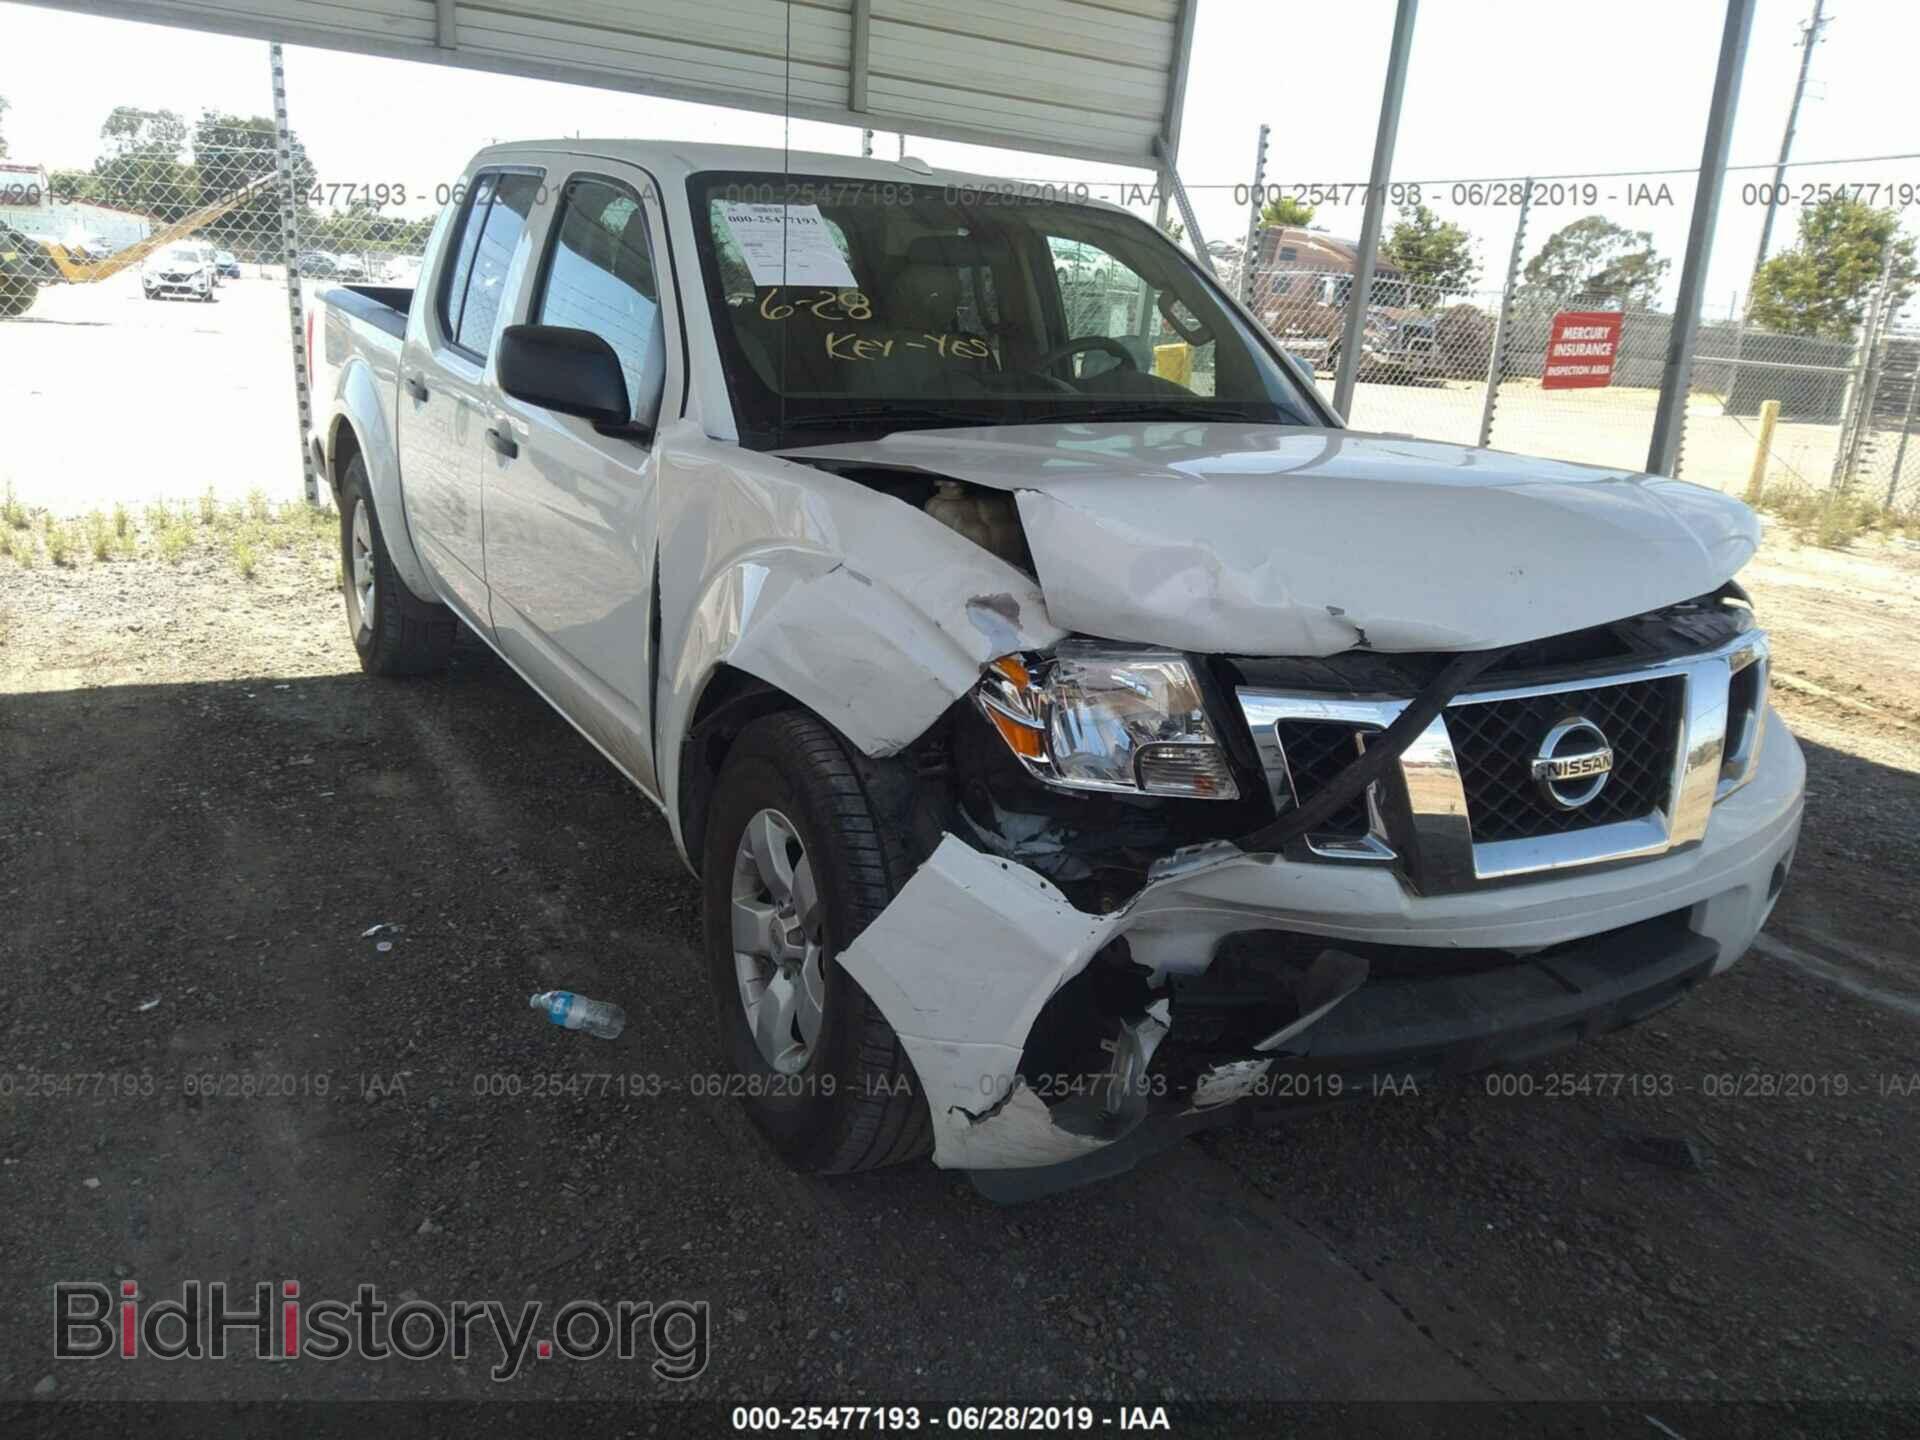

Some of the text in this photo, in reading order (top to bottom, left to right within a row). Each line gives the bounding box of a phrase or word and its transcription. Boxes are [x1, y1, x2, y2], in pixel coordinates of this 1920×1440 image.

[759, 288, 873, 321] 6-28
[1561, 327, 1611, 340] MERCURY
[1553, 343, 1612, 356] INSURANCE
[1547, 366, 1590, 376] INSPECTION
[1547, 755, 1611, 777] NISSAN
